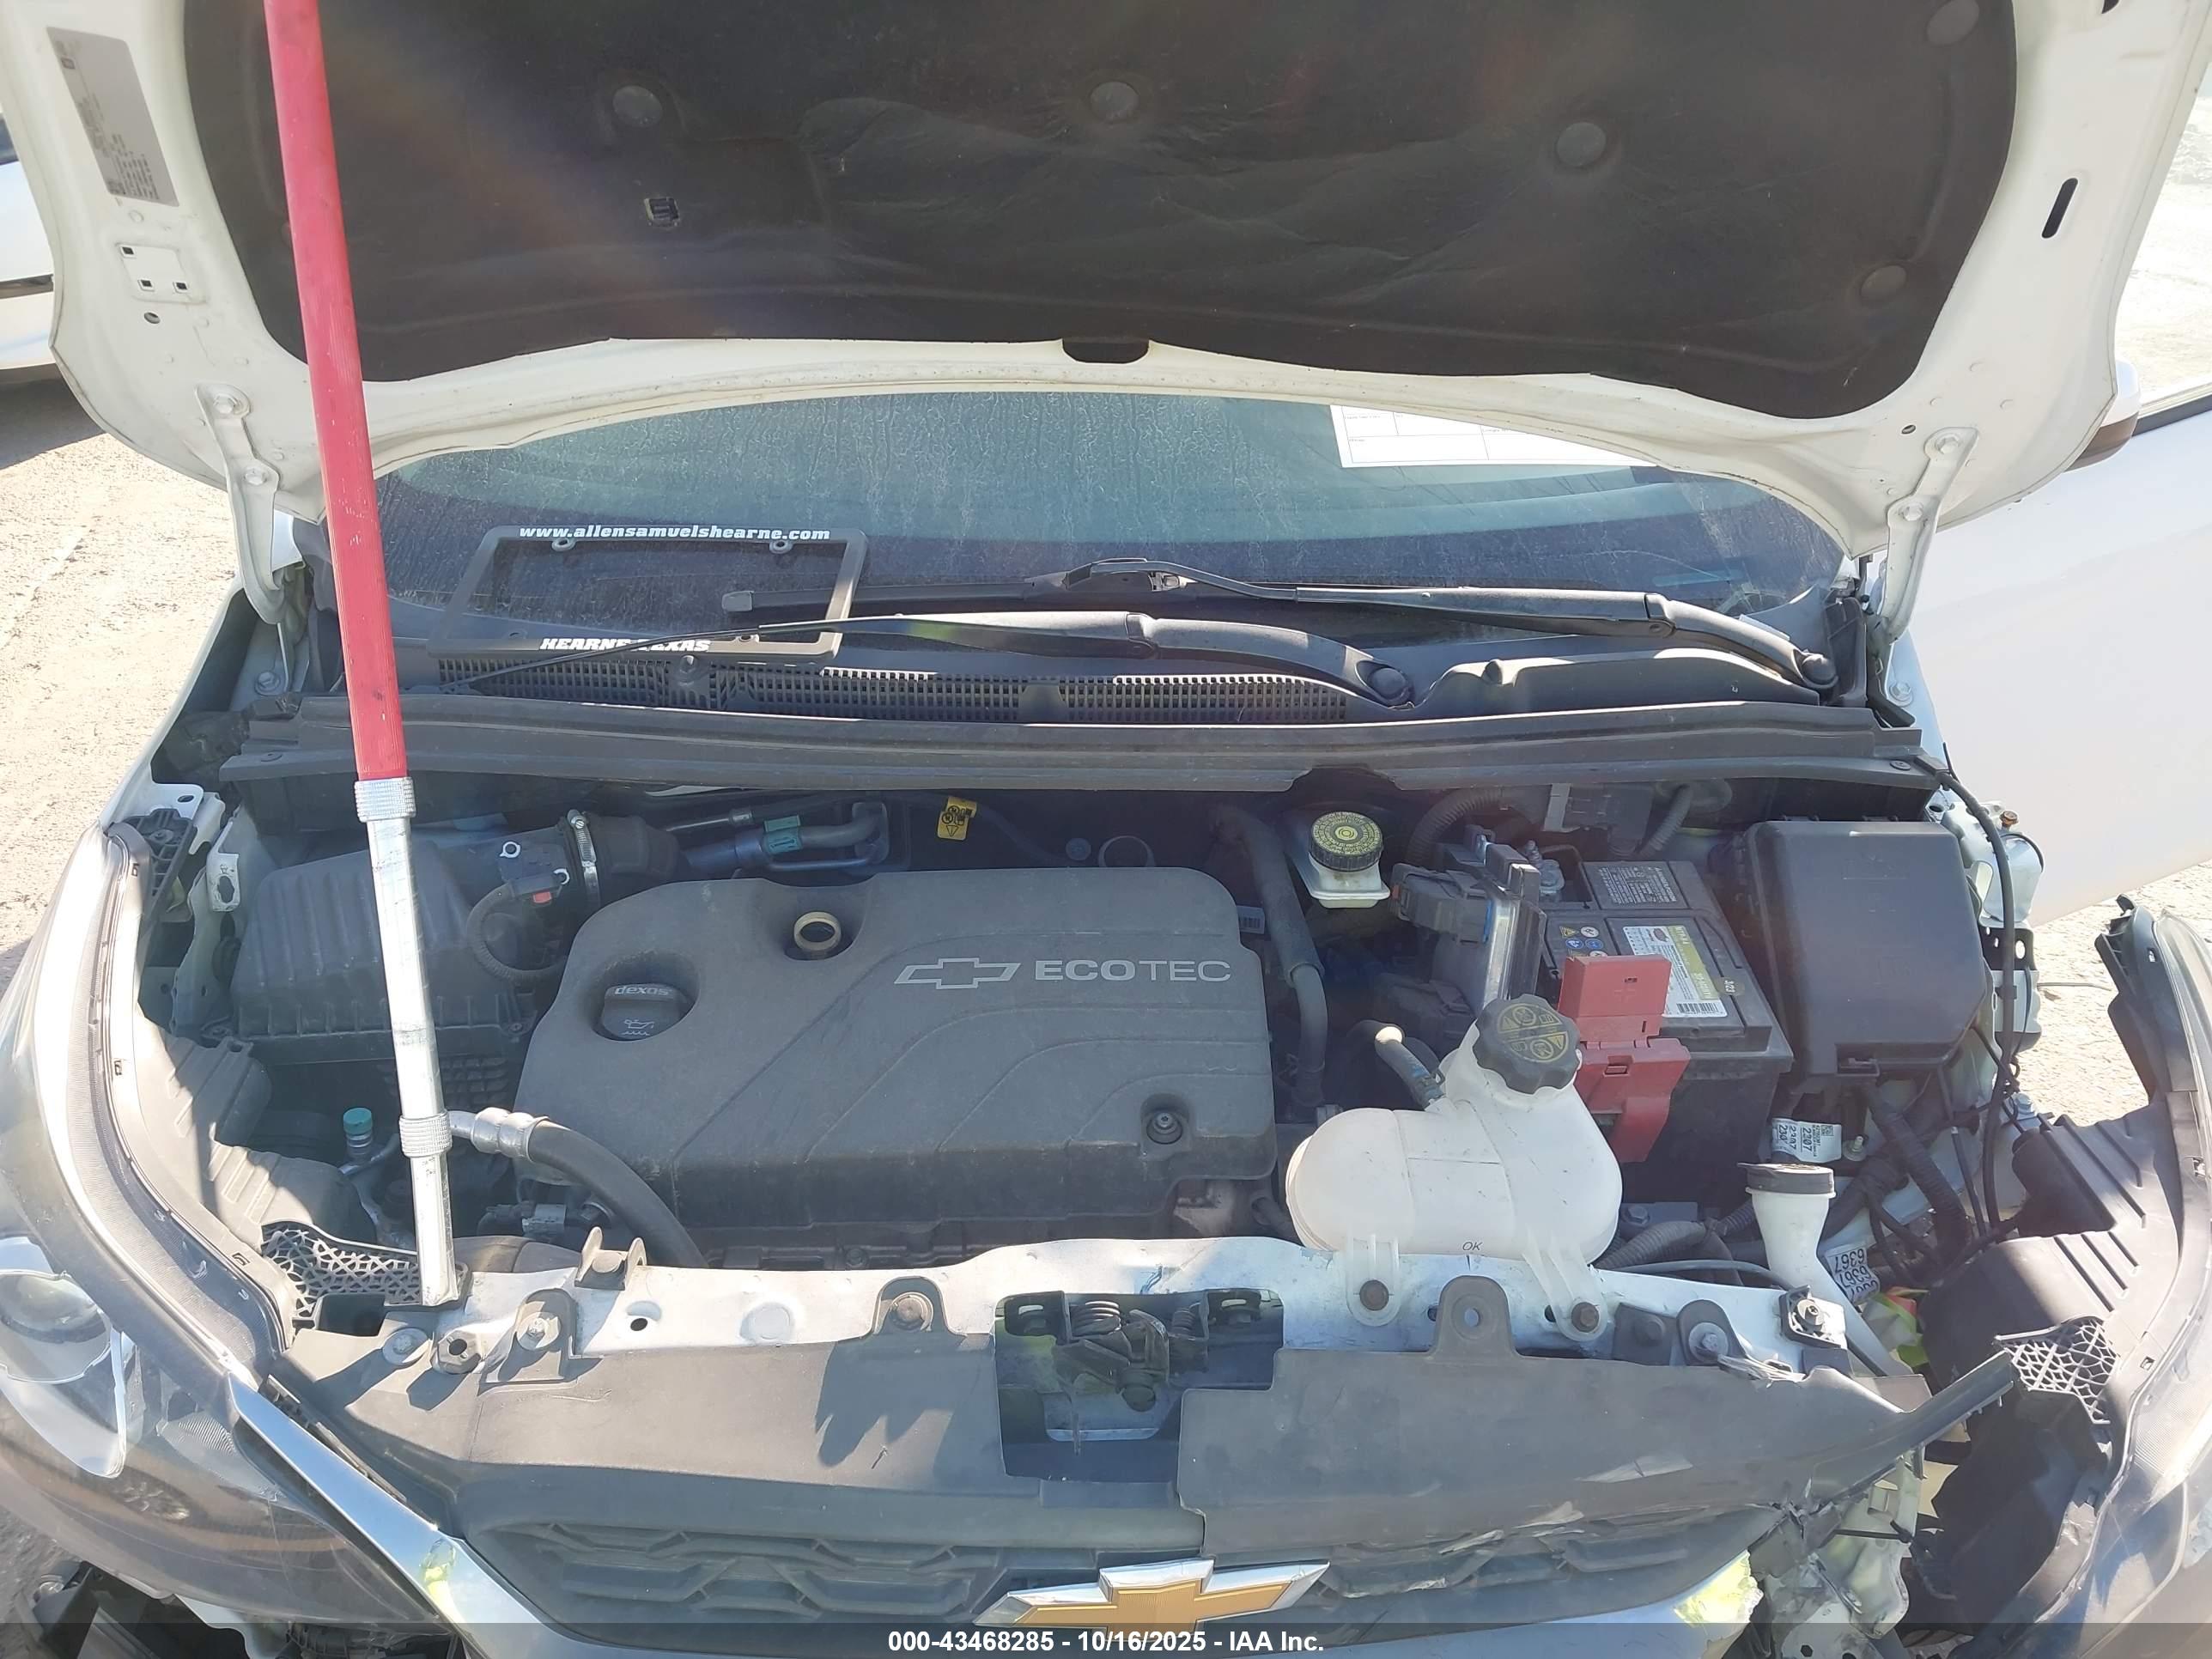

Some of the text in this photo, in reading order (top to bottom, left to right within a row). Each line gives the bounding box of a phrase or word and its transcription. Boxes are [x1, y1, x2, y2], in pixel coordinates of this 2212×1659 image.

[520, 525, 830, 541] www.allensamuelshearne.com
[1035, 959, 1231, 982] ECOTEC
[615, 986, 669, 996] dexos
[1724, 980, 1736, 994] 3/23
[1778, 1124, 1789, 1144] 230
[1462, 1241, 1483, 1251] OK
[1835, 1248, 1865, 1273] 6367
[1839, 1265, 1872, 1288] 6367
